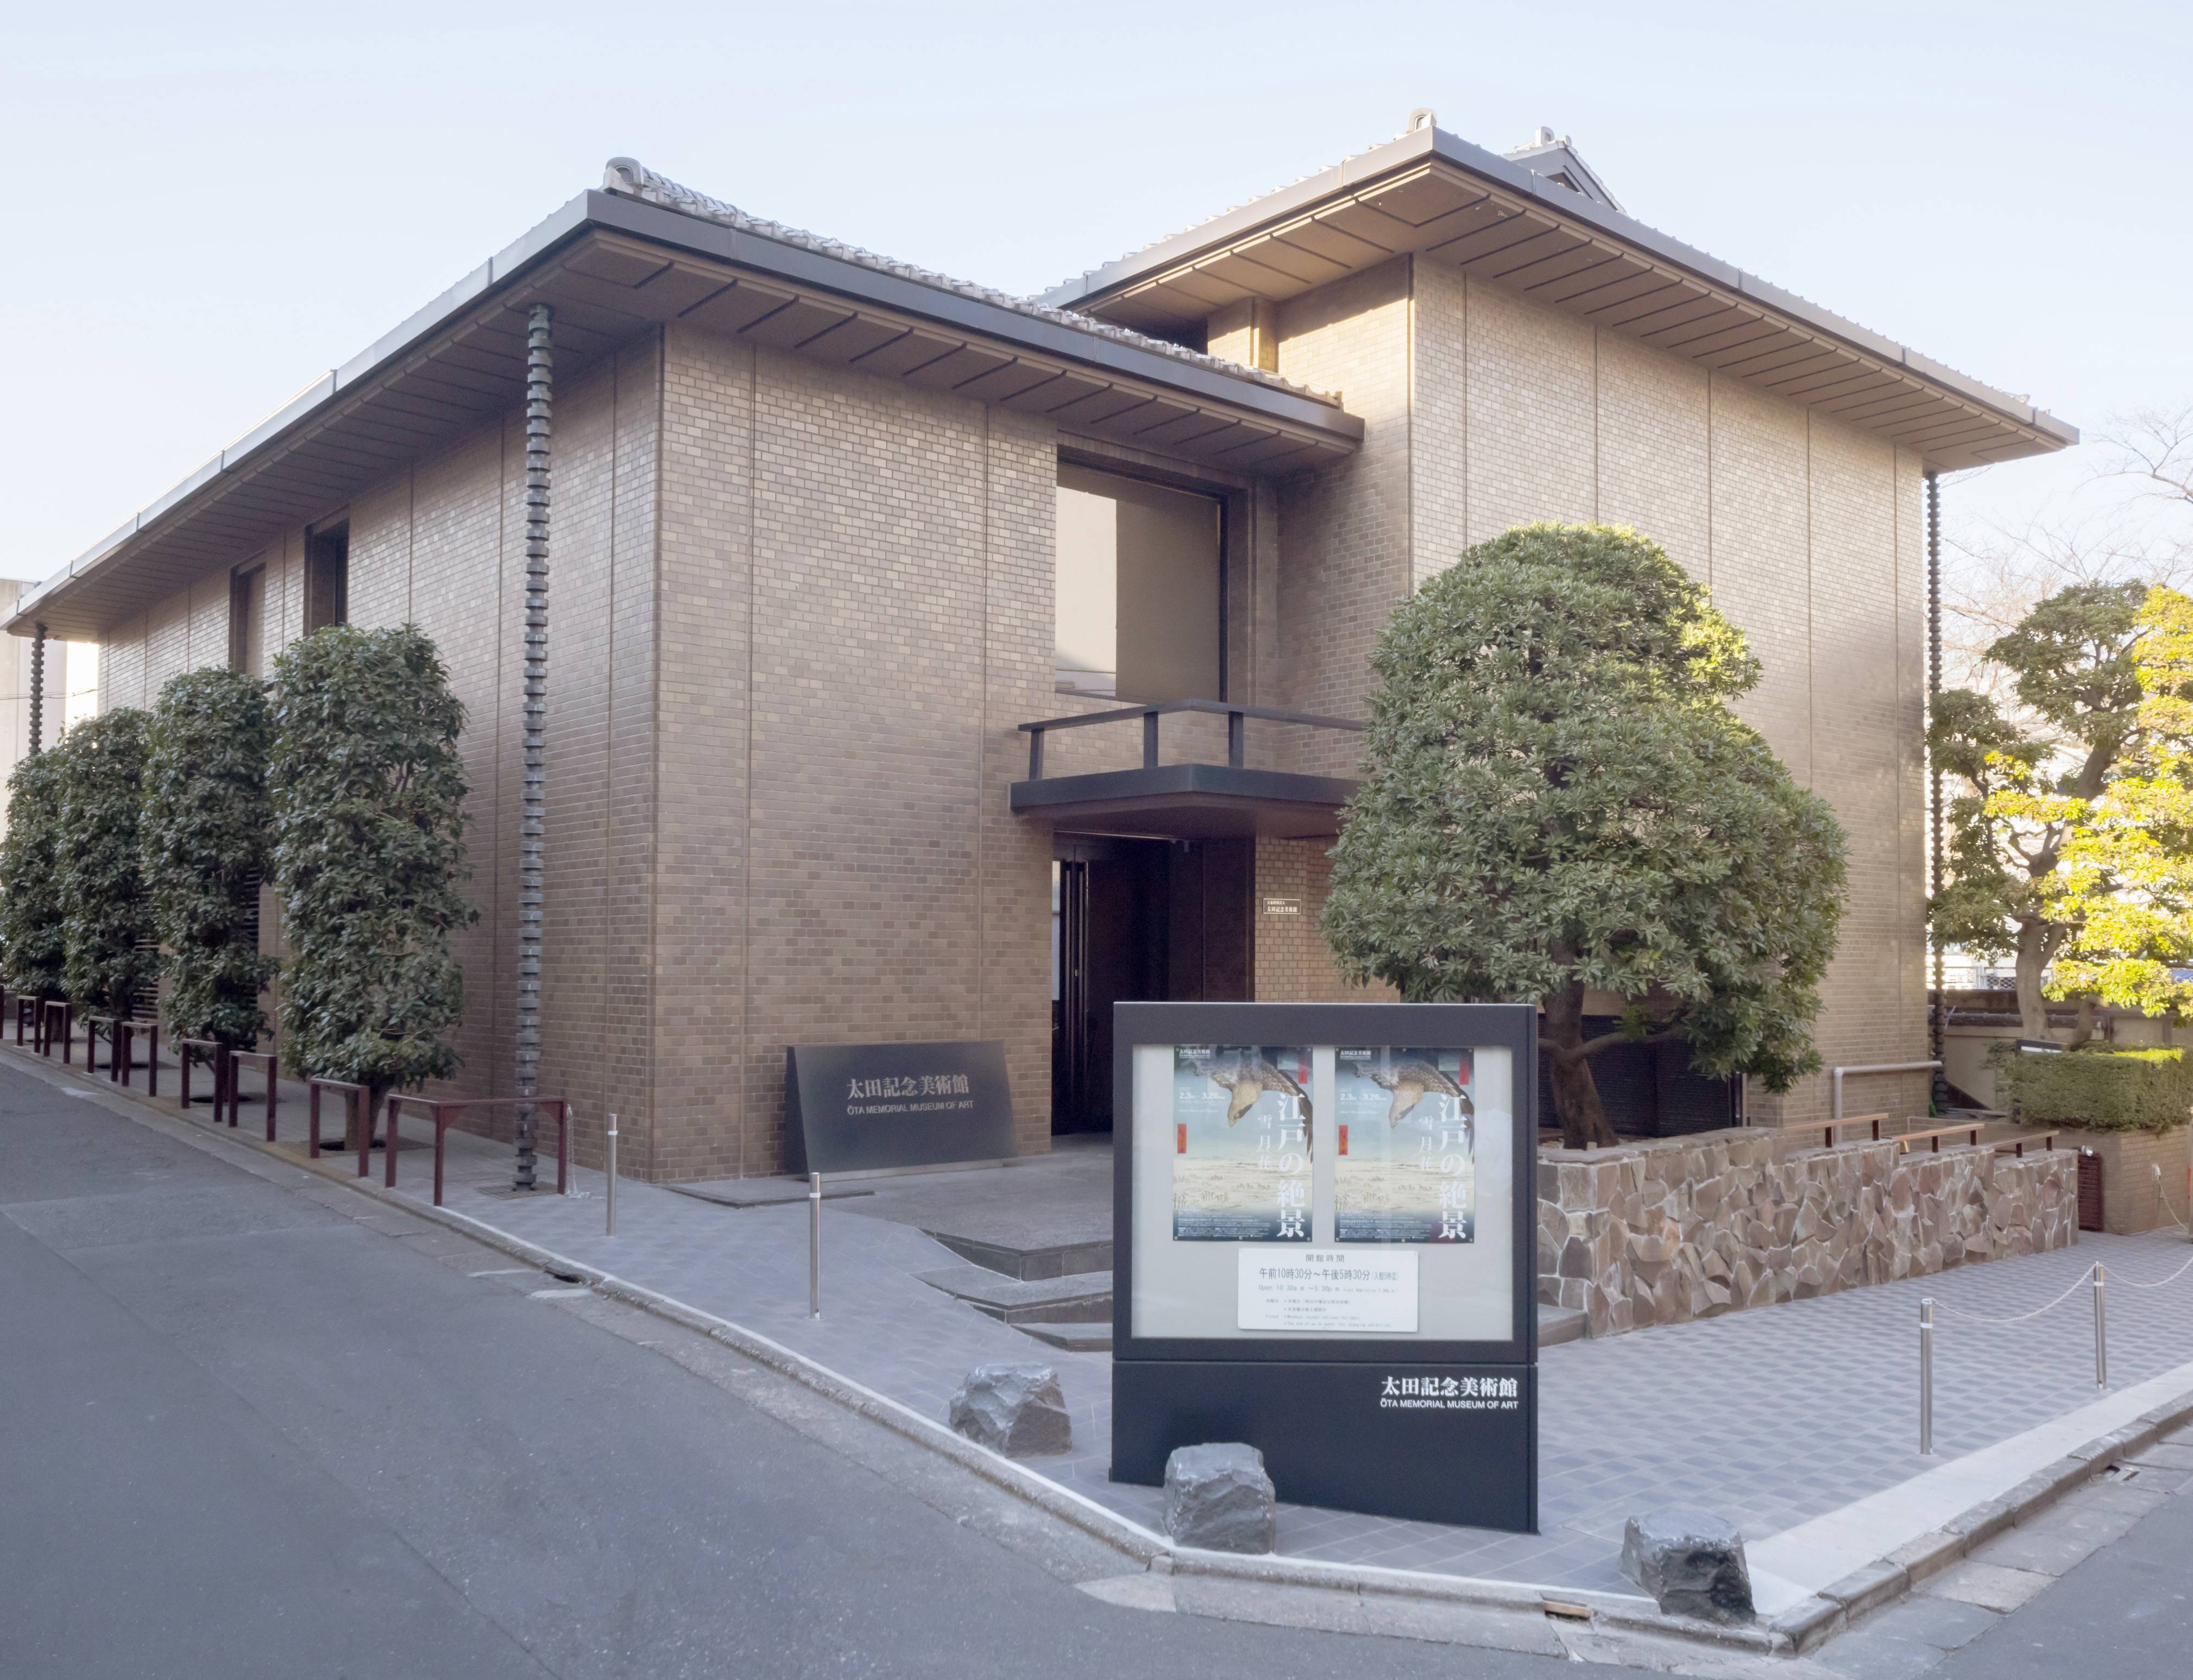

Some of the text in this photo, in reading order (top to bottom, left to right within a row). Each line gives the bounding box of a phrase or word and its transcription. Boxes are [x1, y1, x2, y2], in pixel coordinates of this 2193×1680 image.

[847, 1074, 969, 1099] 太田記念美術館
[847, 1105, 865, 1115] ŌTA
[866, 1104, 909, 1114] MEMORIAL
[910, 1103, 944, 1112] MUSEUM
[958, 1100, 974, 1109] ART
[1256, 1114, 1273, 1170] 雪月花
[1277, 1093, 1306, 1237] 江戸の絶景
[1438, 1094, 1467, 1239] 江戸の絶景
[1306, 1254, 1345, 1262] 開館時間
[1381, 1376, 1518, 1398] 太田記念美術館
[1380, 1398, 1398, 1407] ŌTA
[1400, 1399, 1445, 1408] MEMORIAL
[1447, 1400, 1485, 1408] MUSEUM
[1501, 1401, 1518, 1409] ART
